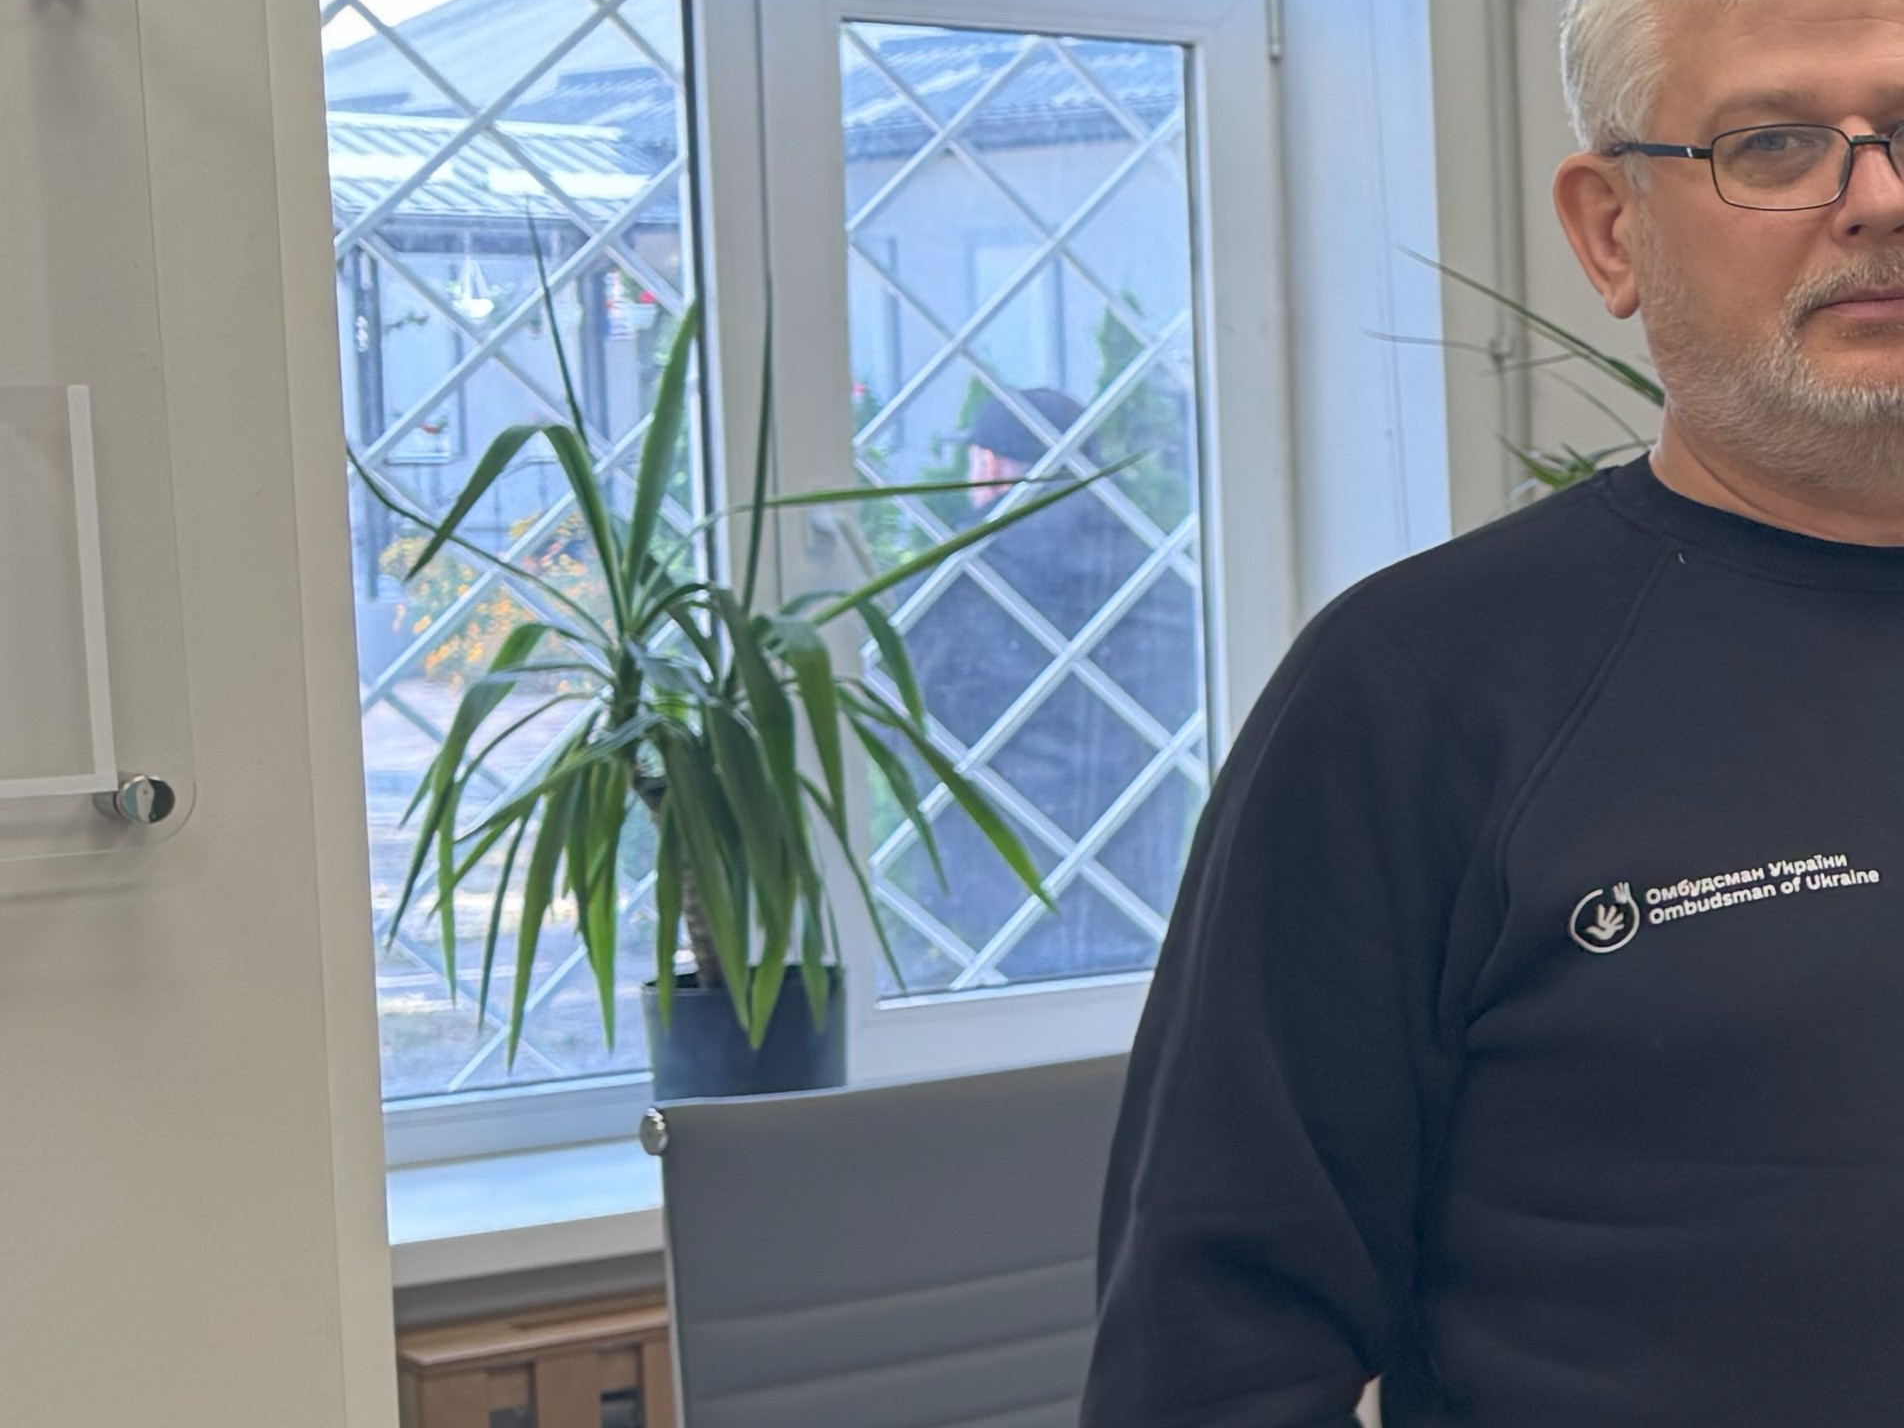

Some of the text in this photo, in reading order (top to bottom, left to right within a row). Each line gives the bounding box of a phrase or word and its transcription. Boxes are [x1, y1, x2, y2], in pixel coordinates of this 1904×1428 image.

[1646, 854, 1847, 905] Омбудсман України
[1650, 869, 1880, 924] Ombudsman of Ukraine
